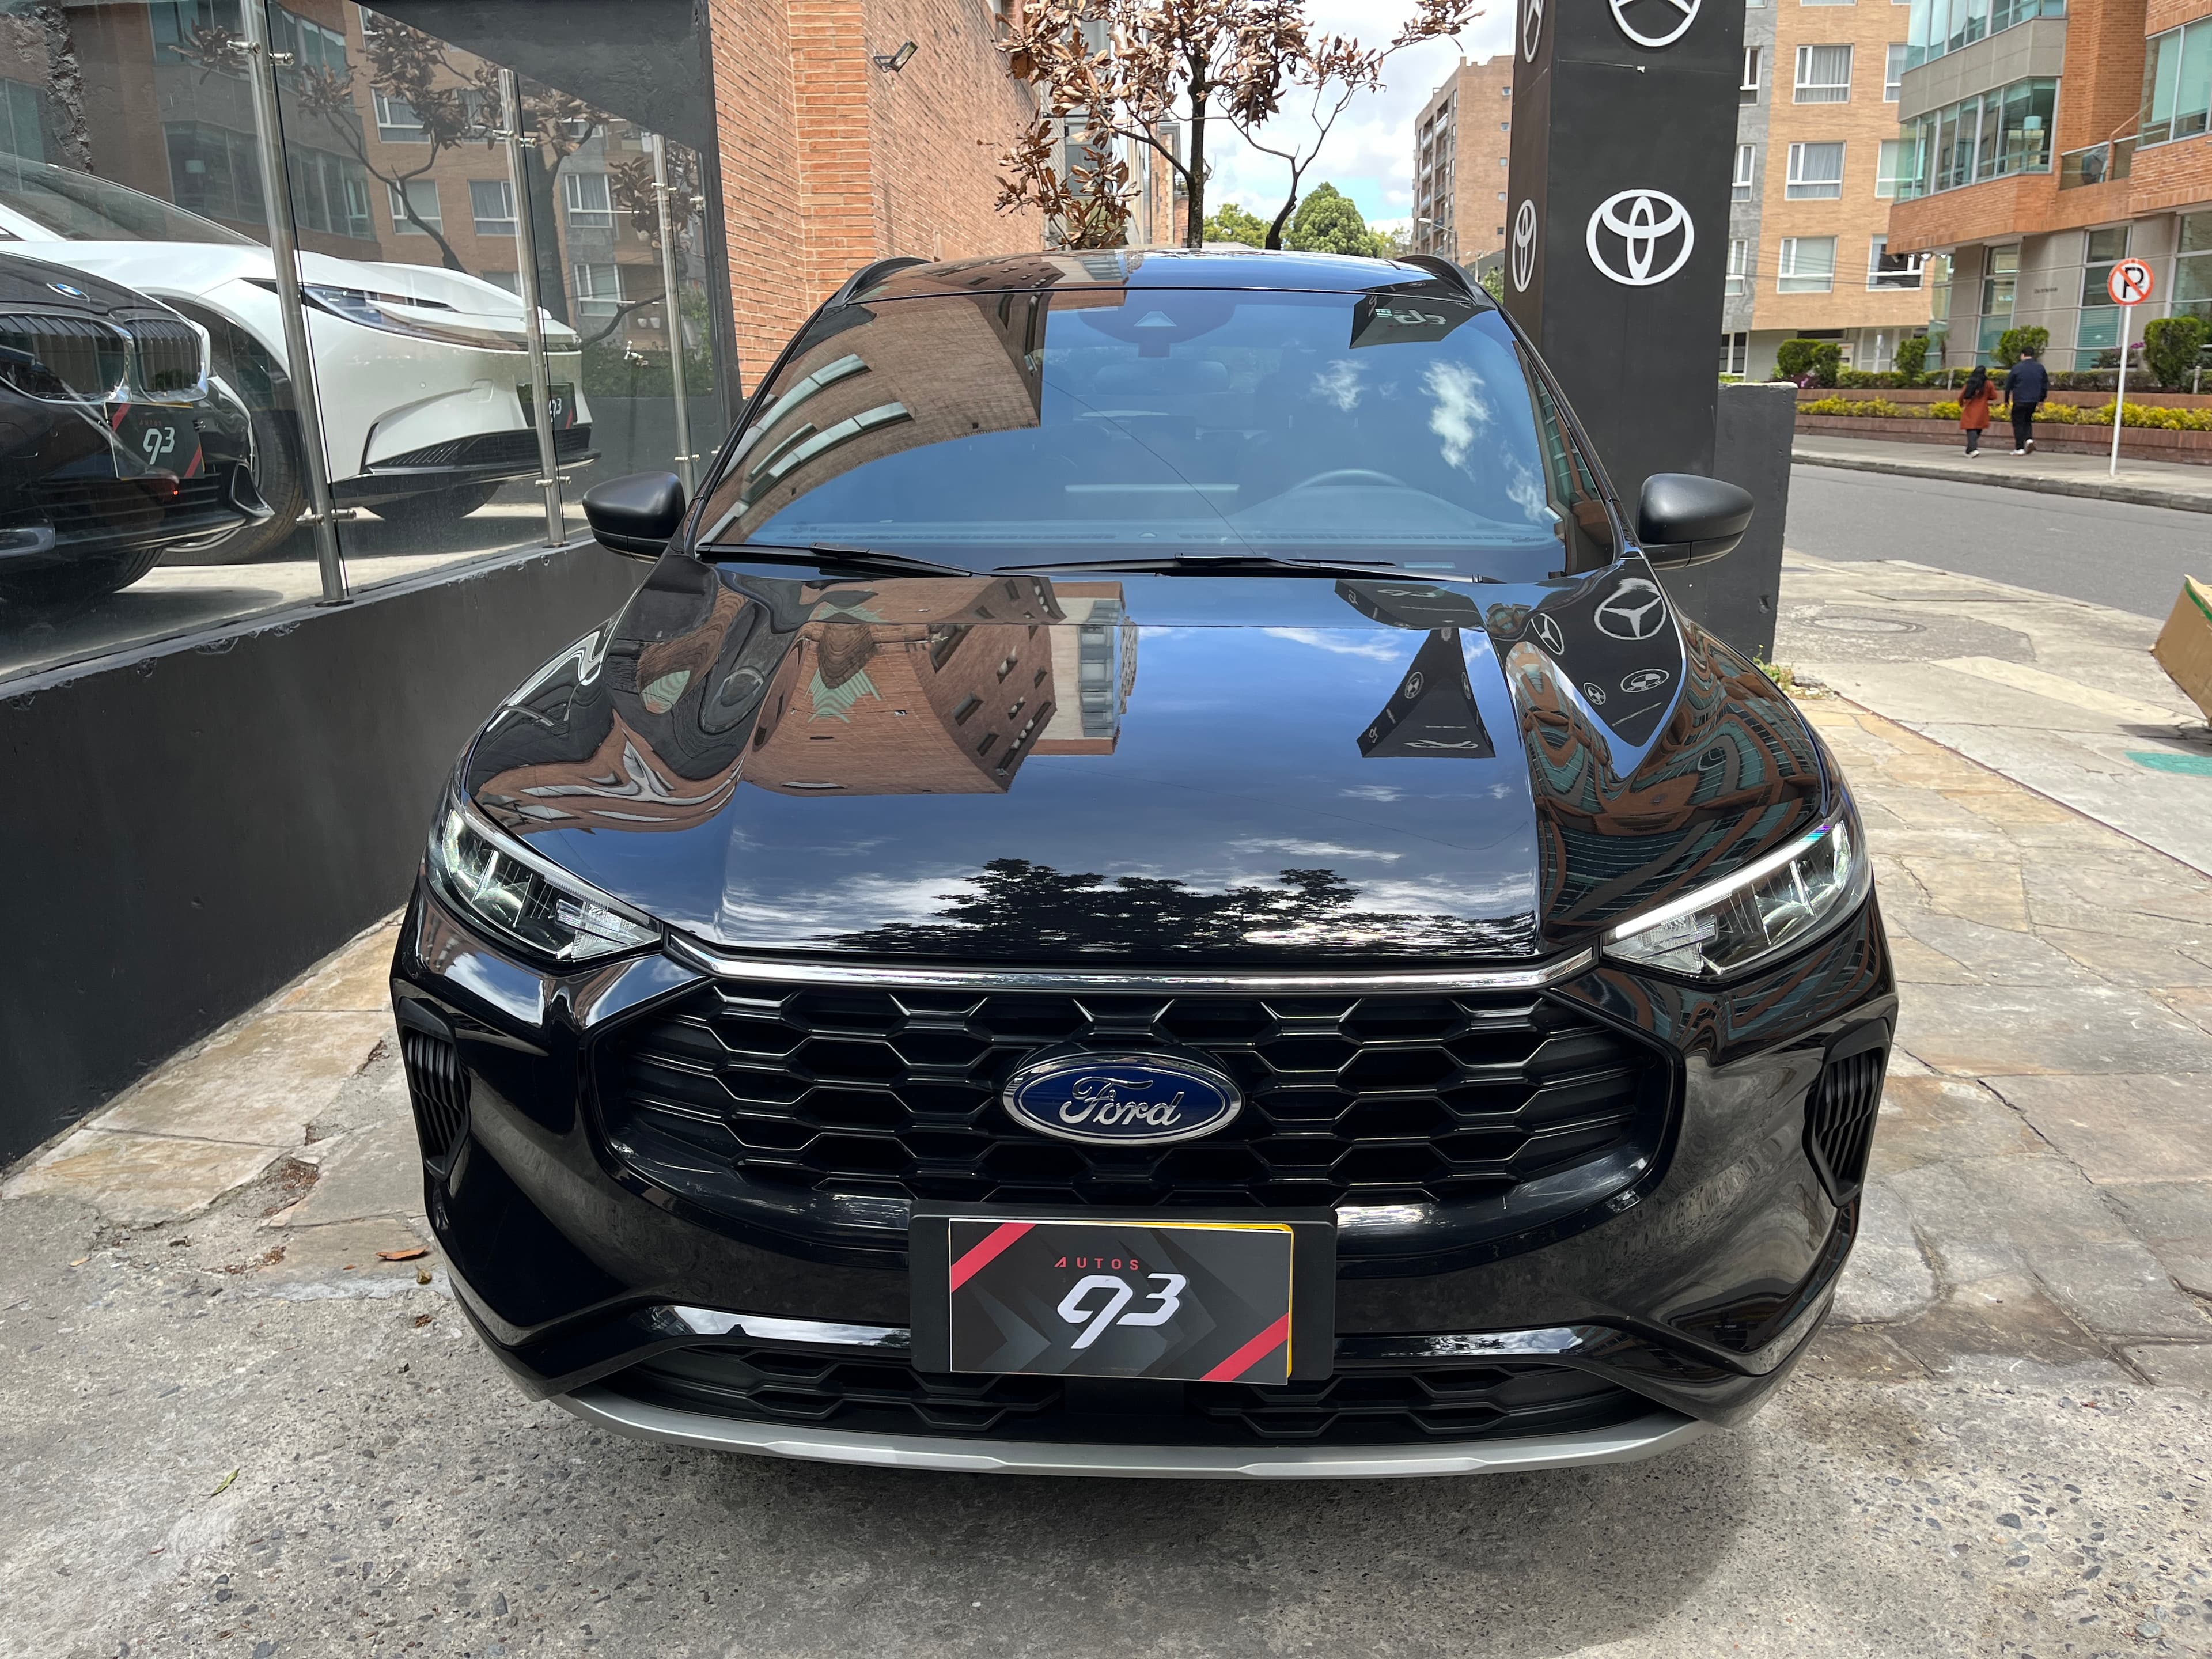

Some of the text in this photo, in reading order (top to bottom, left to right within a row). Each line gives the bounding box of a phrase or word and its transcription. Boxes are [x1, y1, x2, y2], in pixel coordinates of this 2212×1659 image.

[2123, 267, 2143, 298] P
[143, 427, 175, 465] 93
[1059, 1077, 1185, 1126] Ford
[1054, 1256, 1139, 1271] AUTOS
[1057, 1273, 1187, 1349] 93
